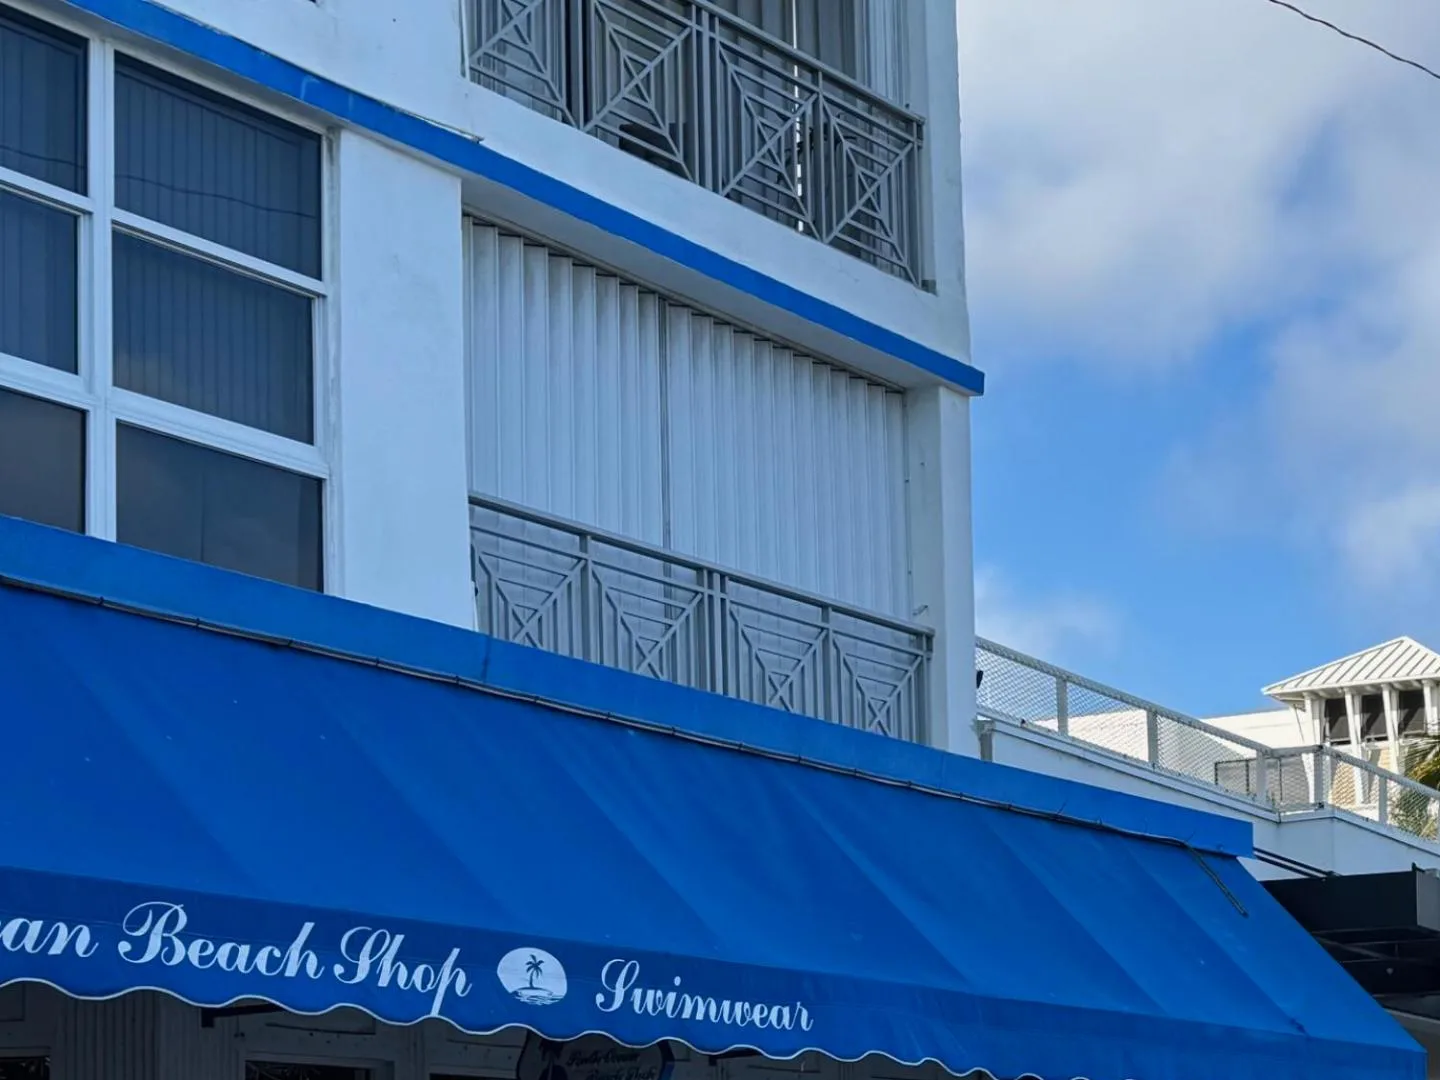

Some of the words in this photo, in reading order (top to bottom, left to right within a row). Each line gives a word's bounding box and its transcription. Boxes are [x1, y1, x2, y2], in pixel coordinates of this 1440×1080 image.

[0, 917, 99, 958] an
[117, 901, 325, 979] Beach
[333, 925, 473, 1016] Shop
[595, 958, 813, 1032] Swimwear
